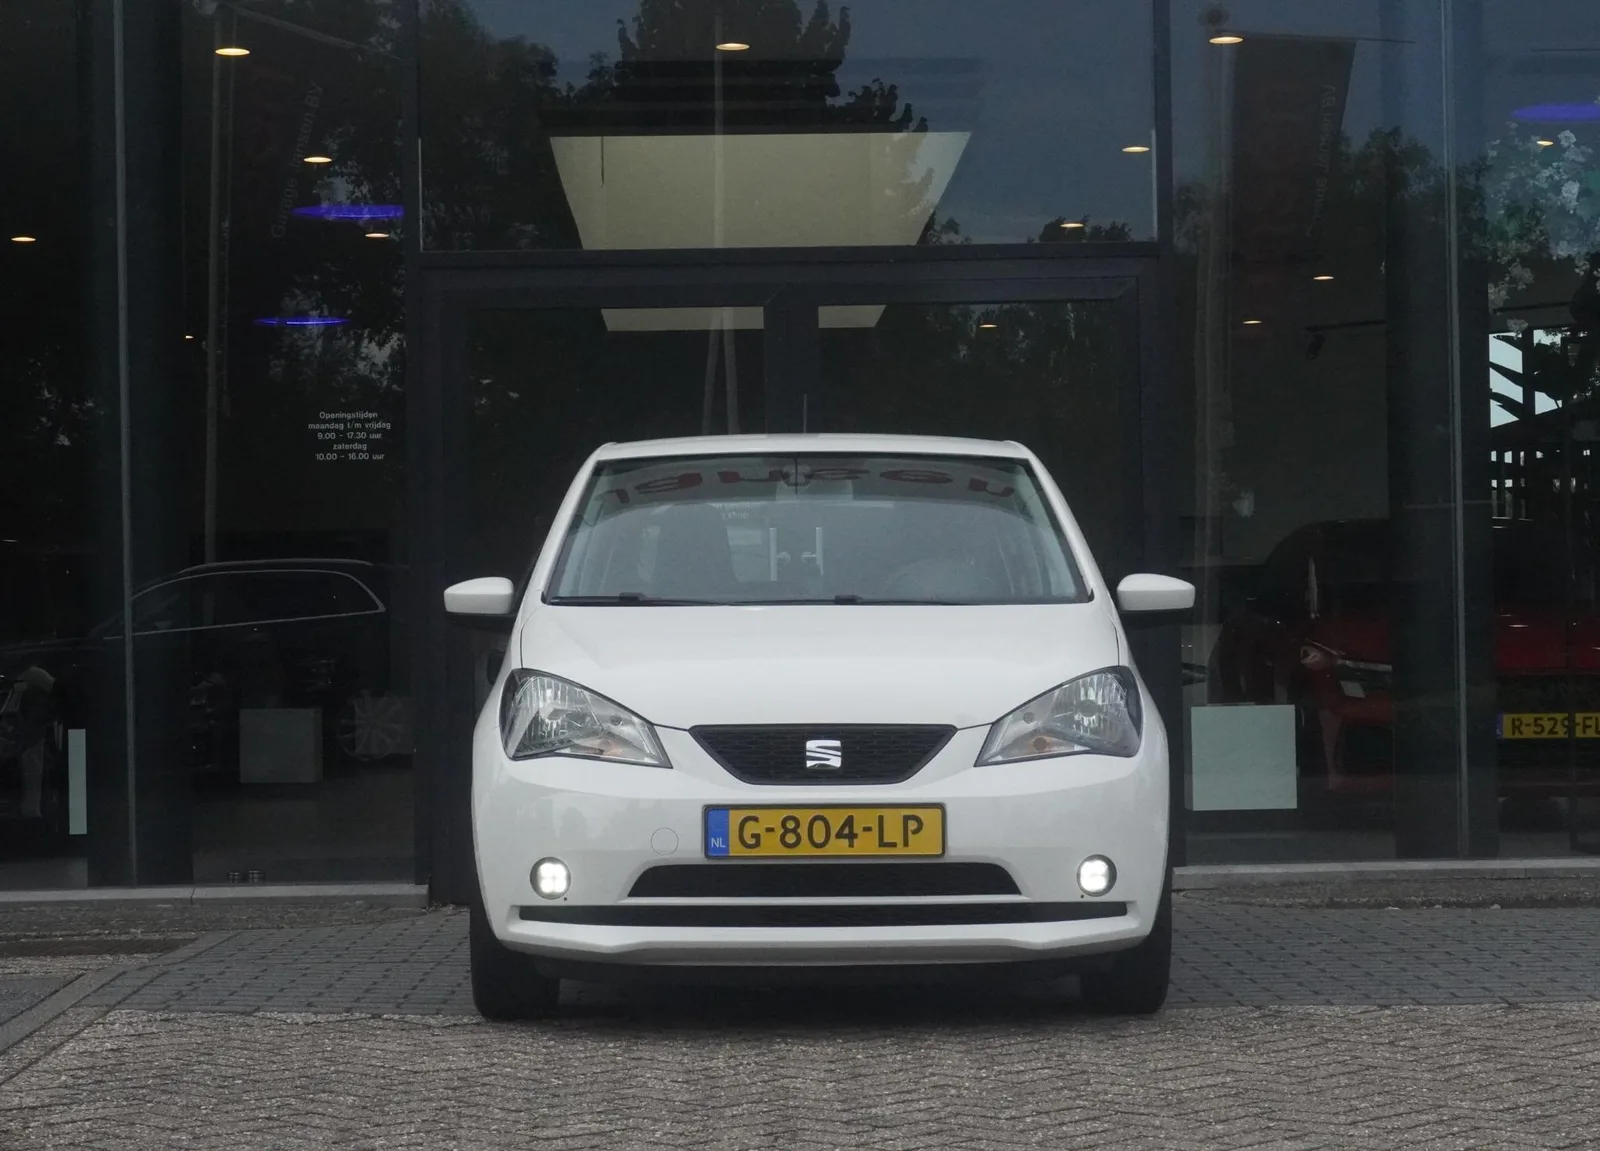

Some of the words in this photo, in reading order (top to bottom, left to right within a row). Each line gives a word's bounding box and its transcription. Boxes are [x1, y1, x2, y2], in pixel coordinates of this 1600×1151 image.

[318, 411, 378, 420] Openingstijden
[308, 422, 344, 430] maandag
[347, 421, 362, 429] t/m
[364, 421, 392, 430] vrijdag
[317, 432, 336, 440] 9.00
[346, 431, 367, 440] 17.30
[332, 442, 368, 451] zaterdag
[315, 452, 338, 461] 10.00
[347, 452, 370, 461] 16.00
[738, 815, 924, 849] G-804-LP
[710, 837, 726, 848] NL
